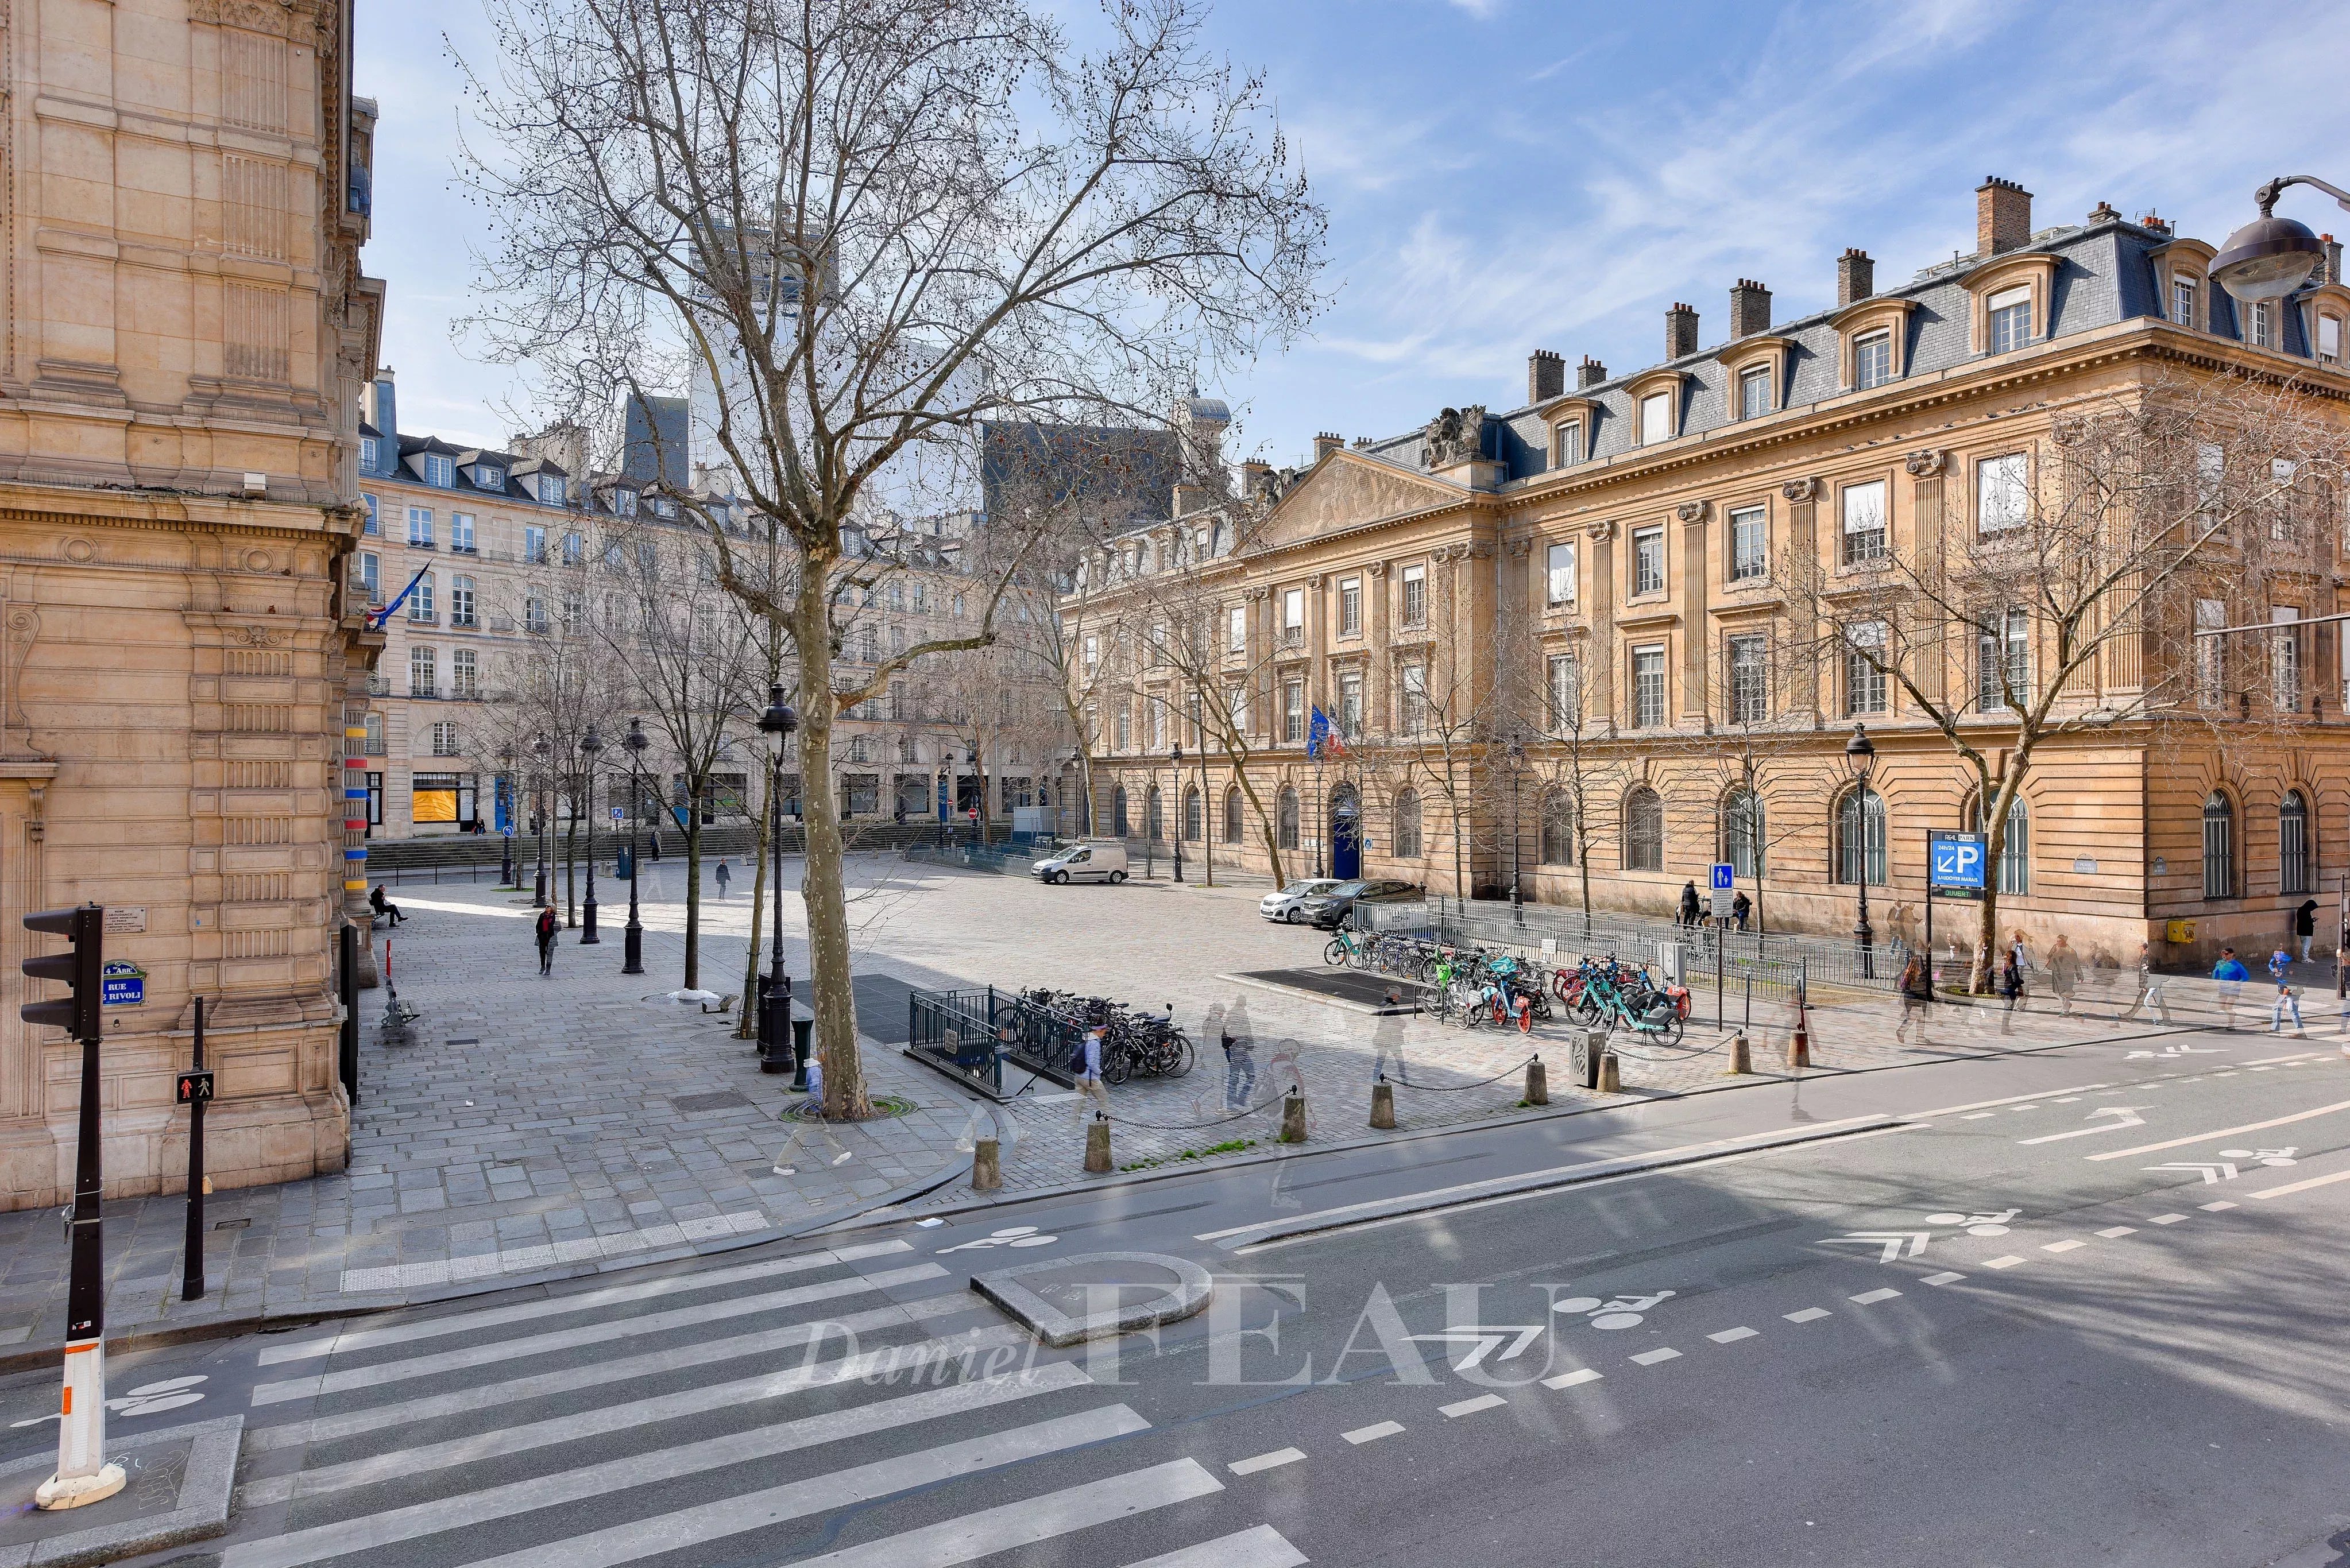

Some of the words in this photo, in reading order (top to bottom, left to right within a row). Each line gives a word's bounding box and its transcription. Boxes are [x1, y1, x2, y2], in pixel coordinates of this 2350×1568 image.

[1957, 846, 1978, 873] P
[108, 983, 126, 991] RUE
[109, 992, 141, 1000] RIVOLI
